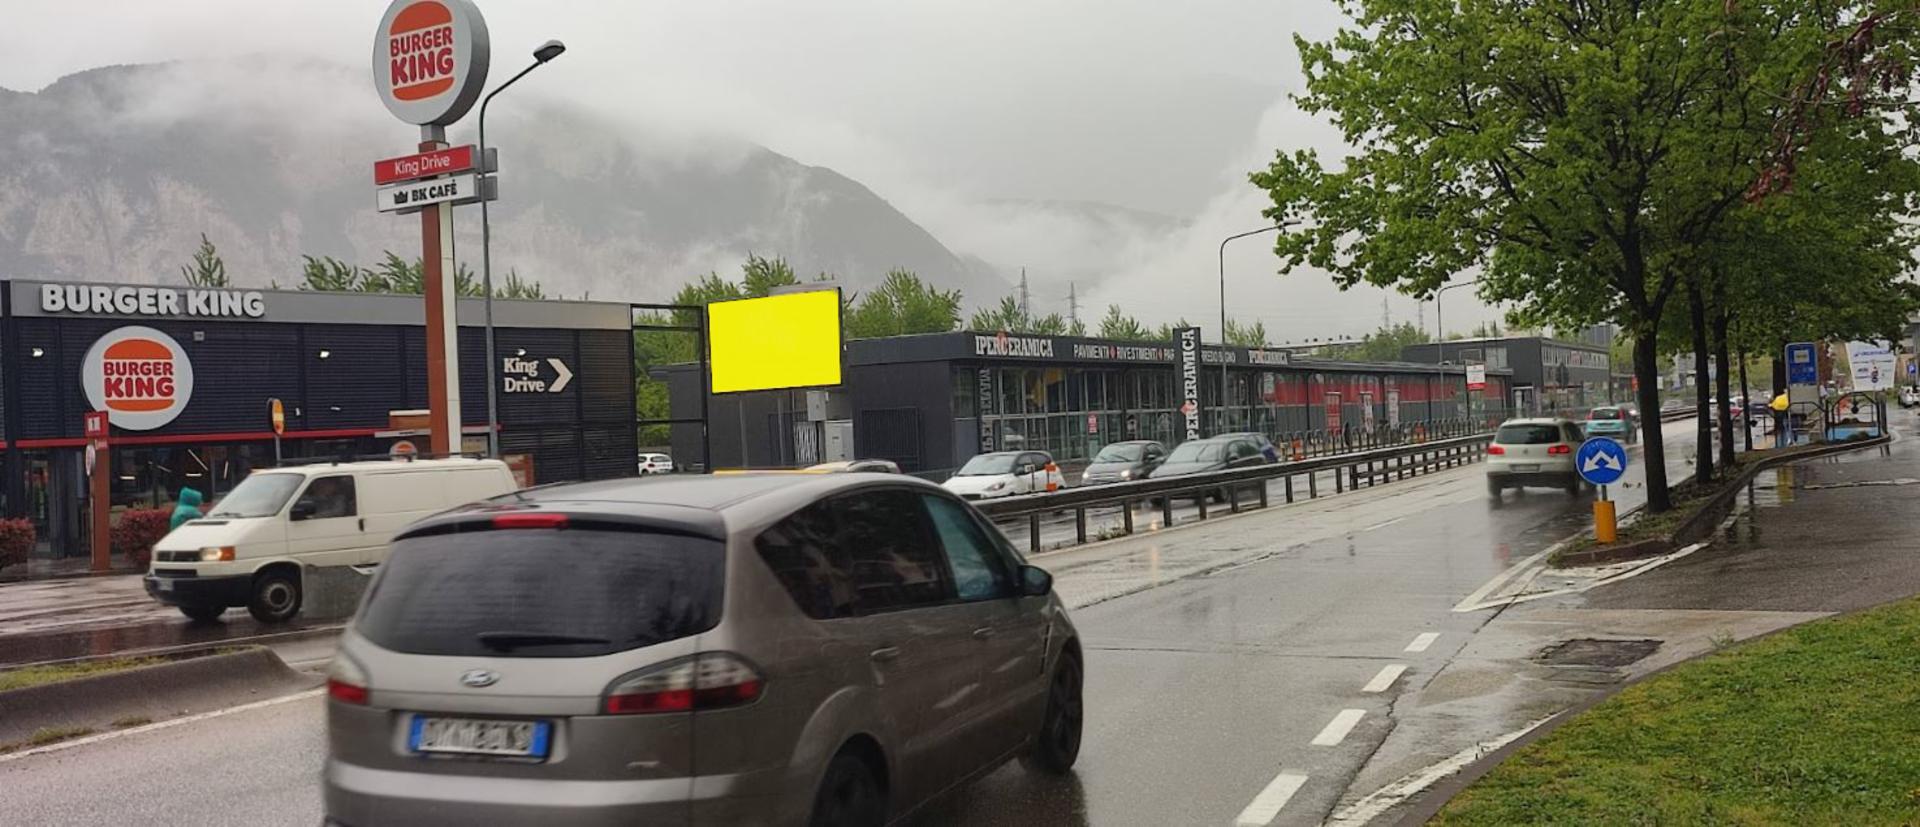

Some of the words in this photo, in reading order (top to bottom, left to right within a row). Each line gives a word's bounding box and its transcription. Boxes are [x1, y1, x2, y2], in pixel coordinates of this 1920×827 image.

[391, 27, 453, 57] BURGER
[391, 47, 454, 86] KING
[394, 160, 419, 175] King
[421, 154, 450, 170] Drive
[412, 187, 427, 201] BK
[429, 179, 457, 198] CAFÉ
[42, 284, 180, 314] BURGER
[187, 289, 265, 317] KING
[975, 335, 1053, 357] IPERCERAMICA
[103, 361, 174, 376] BURGER
[504, 357, 539, 377] King
[104, 377, 175, 399] KING
[503, 376, 545, 392] Drive
